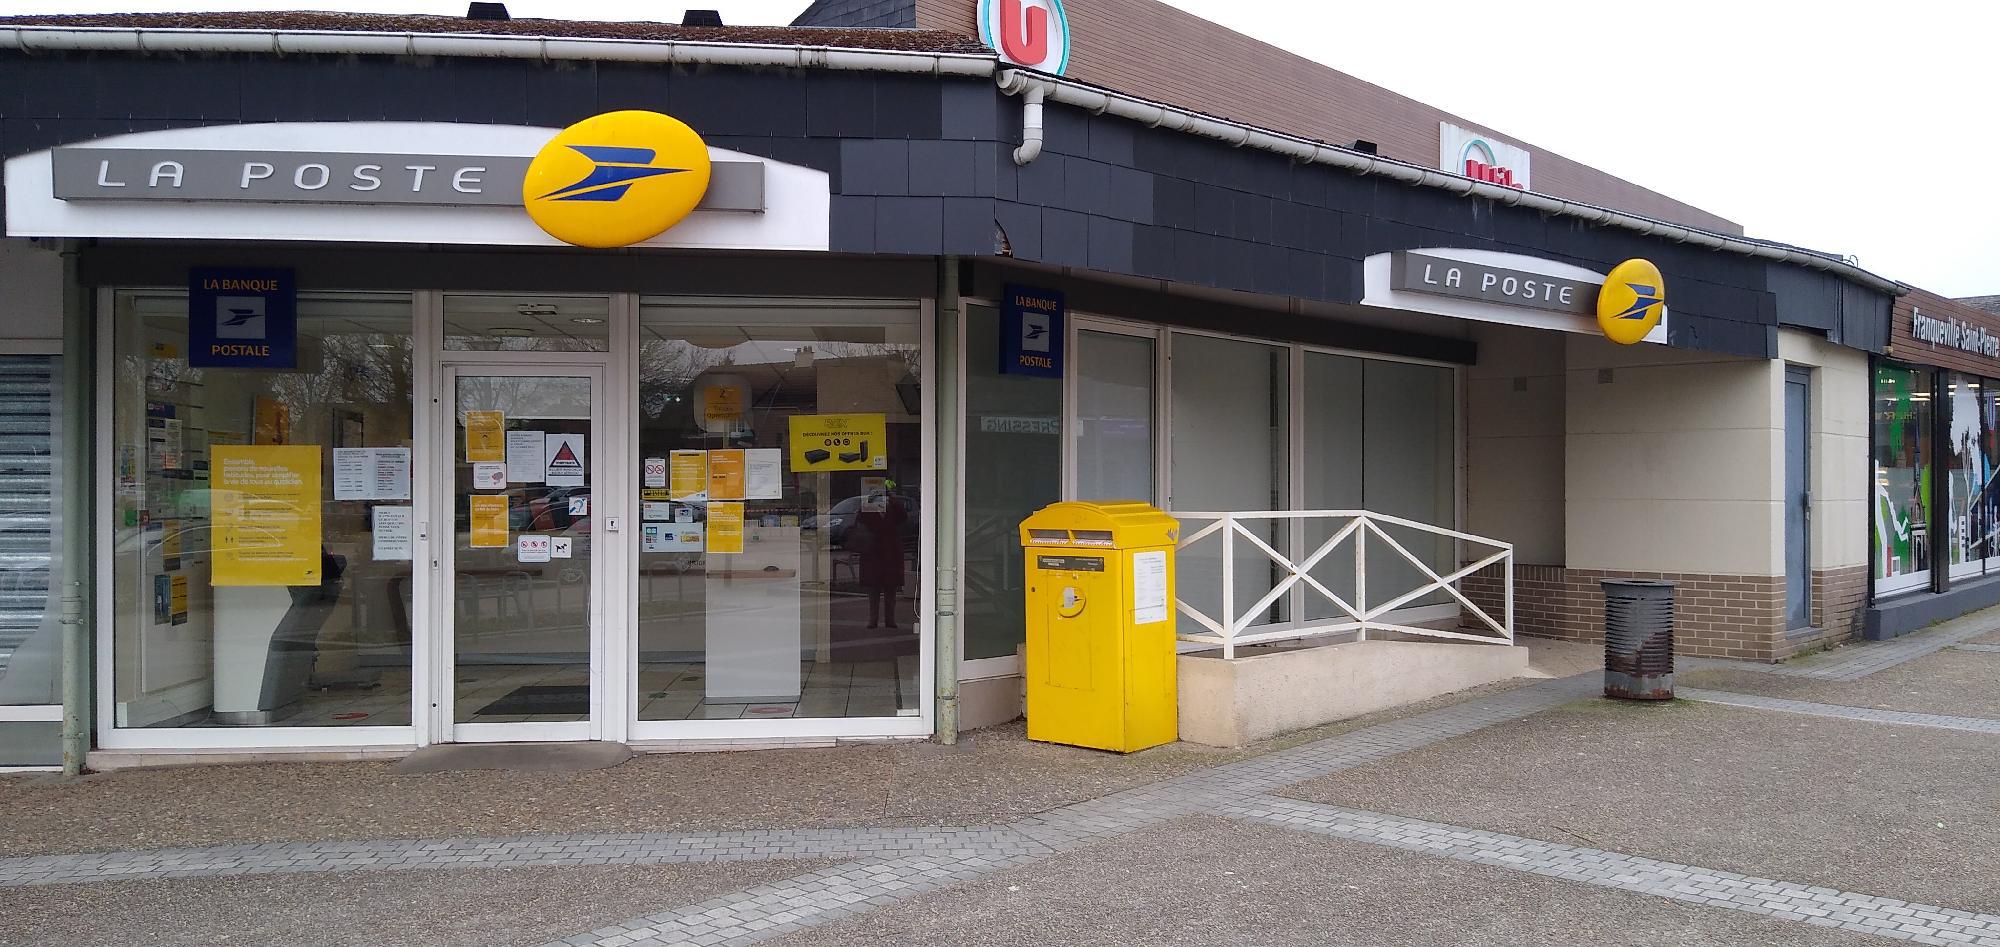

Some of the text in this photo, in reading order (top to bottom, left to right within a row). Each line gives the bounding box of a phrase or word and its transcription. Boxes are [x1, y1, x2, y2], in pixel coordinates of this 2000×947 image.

[1000, 0, 1048, 66] U
[97, 160, 487, 193] LA POSTE
[203, 279, 278, 292] LA BANQUE
[1424, 263, 1573, 305] LA POSTE
[1015, 295, 1057, 311] LA BANQUE
[1912, 306, 2000, 358] Franqueville Saint-Pierre
[211, 345, 270, 356] POSTALE
[1019, 355, 1052, 368] POSTALE
